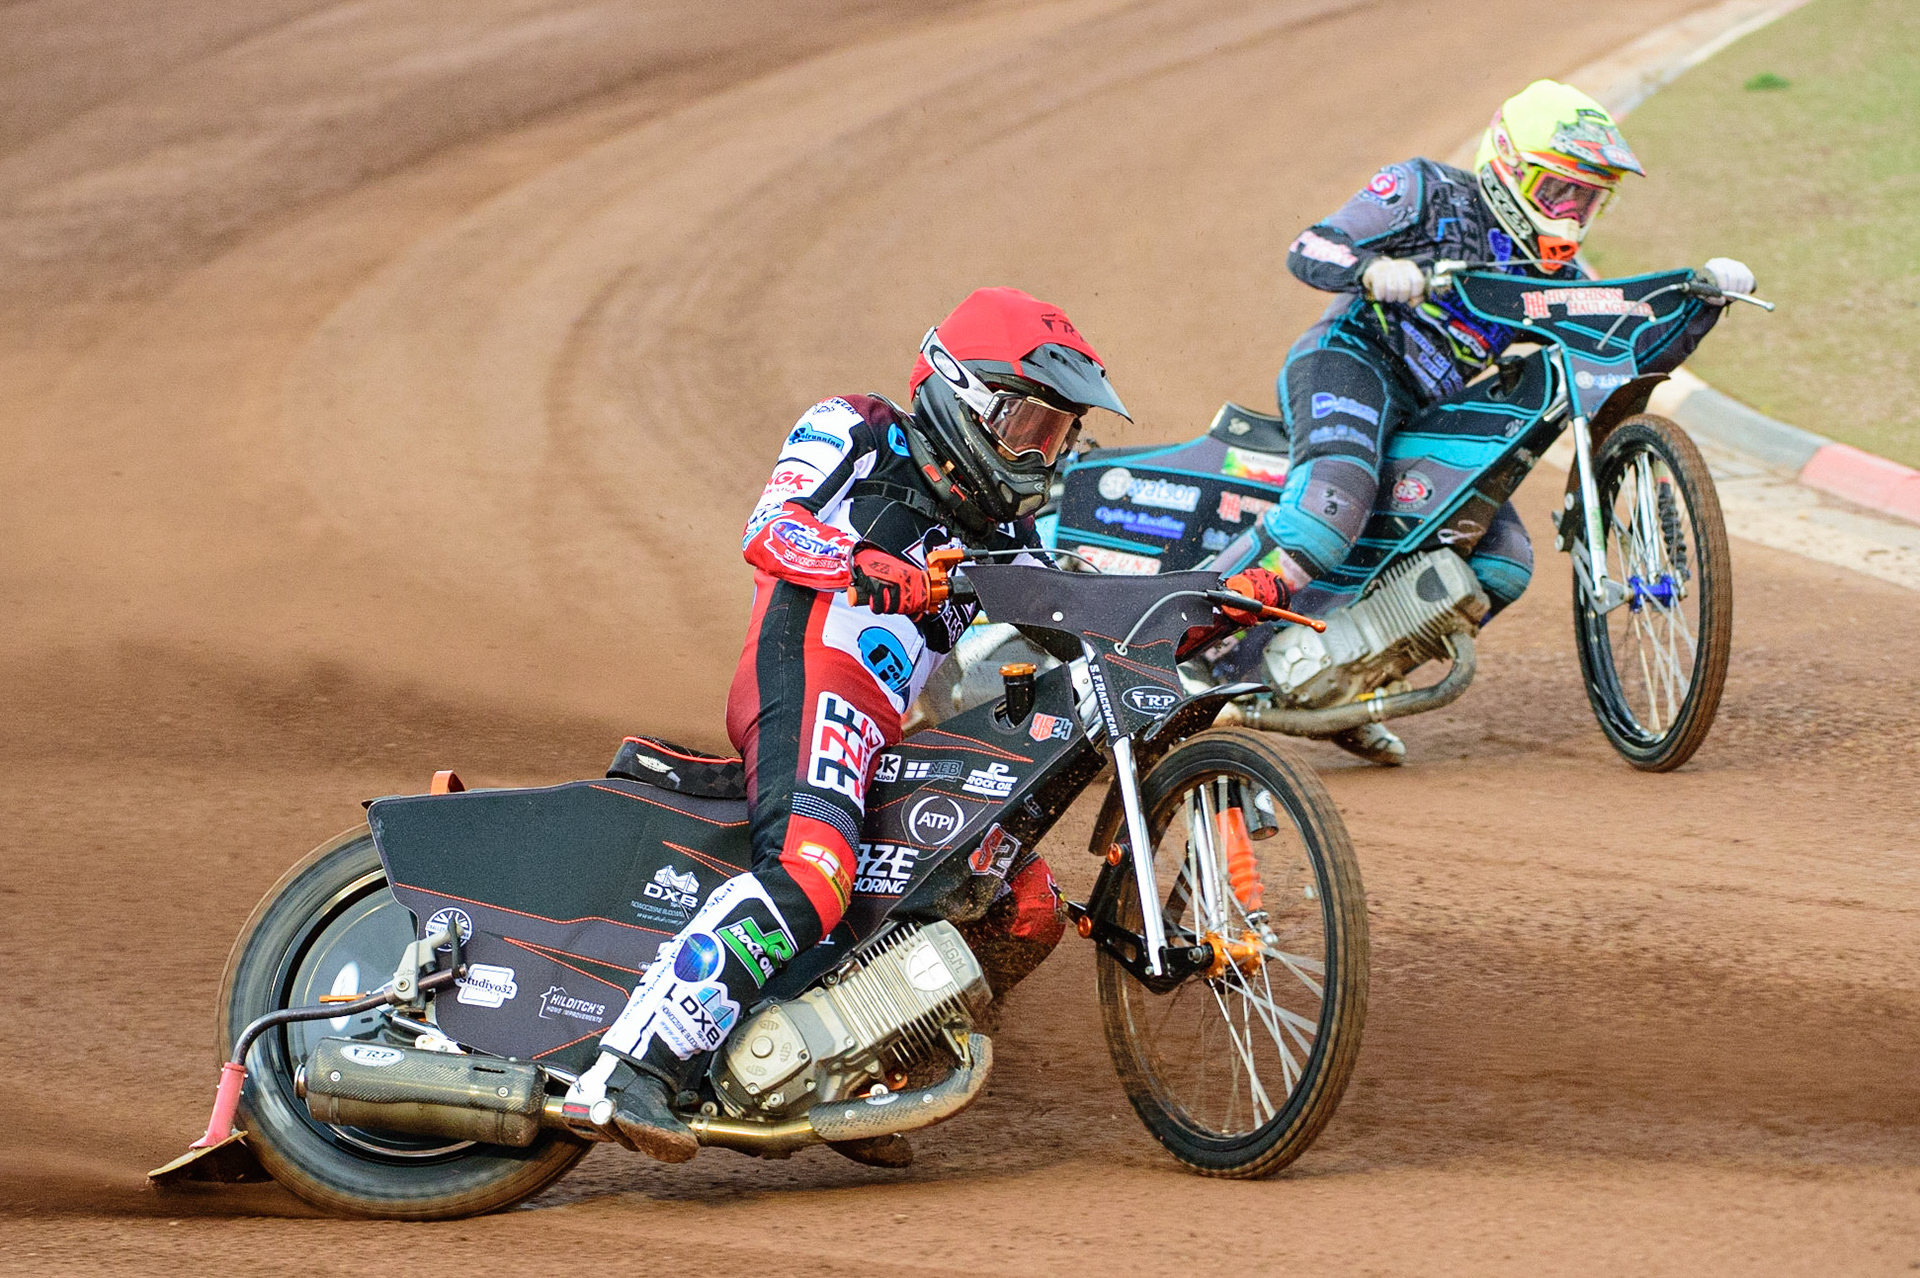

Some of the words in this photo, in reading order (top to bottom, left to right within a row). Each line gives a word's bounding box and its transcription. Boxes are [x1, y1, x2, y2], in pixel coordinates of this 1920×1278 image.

[929, 761, 959, 776] NEB
[965, 776, 996, 790] ROCK
[997, 781, 1013, 792] OIL
[917, 811, 955, 831] ATPI
[643, 882, 699, 908] DXB
[853, 878, 908, 894] HORING
[729, 923, 765, 961] ROCK
[759, 957, 775, 980] OIL
[550, 994, 606, 1015] HILDITCH'S
[680, 995, 720, 1046] DXB
